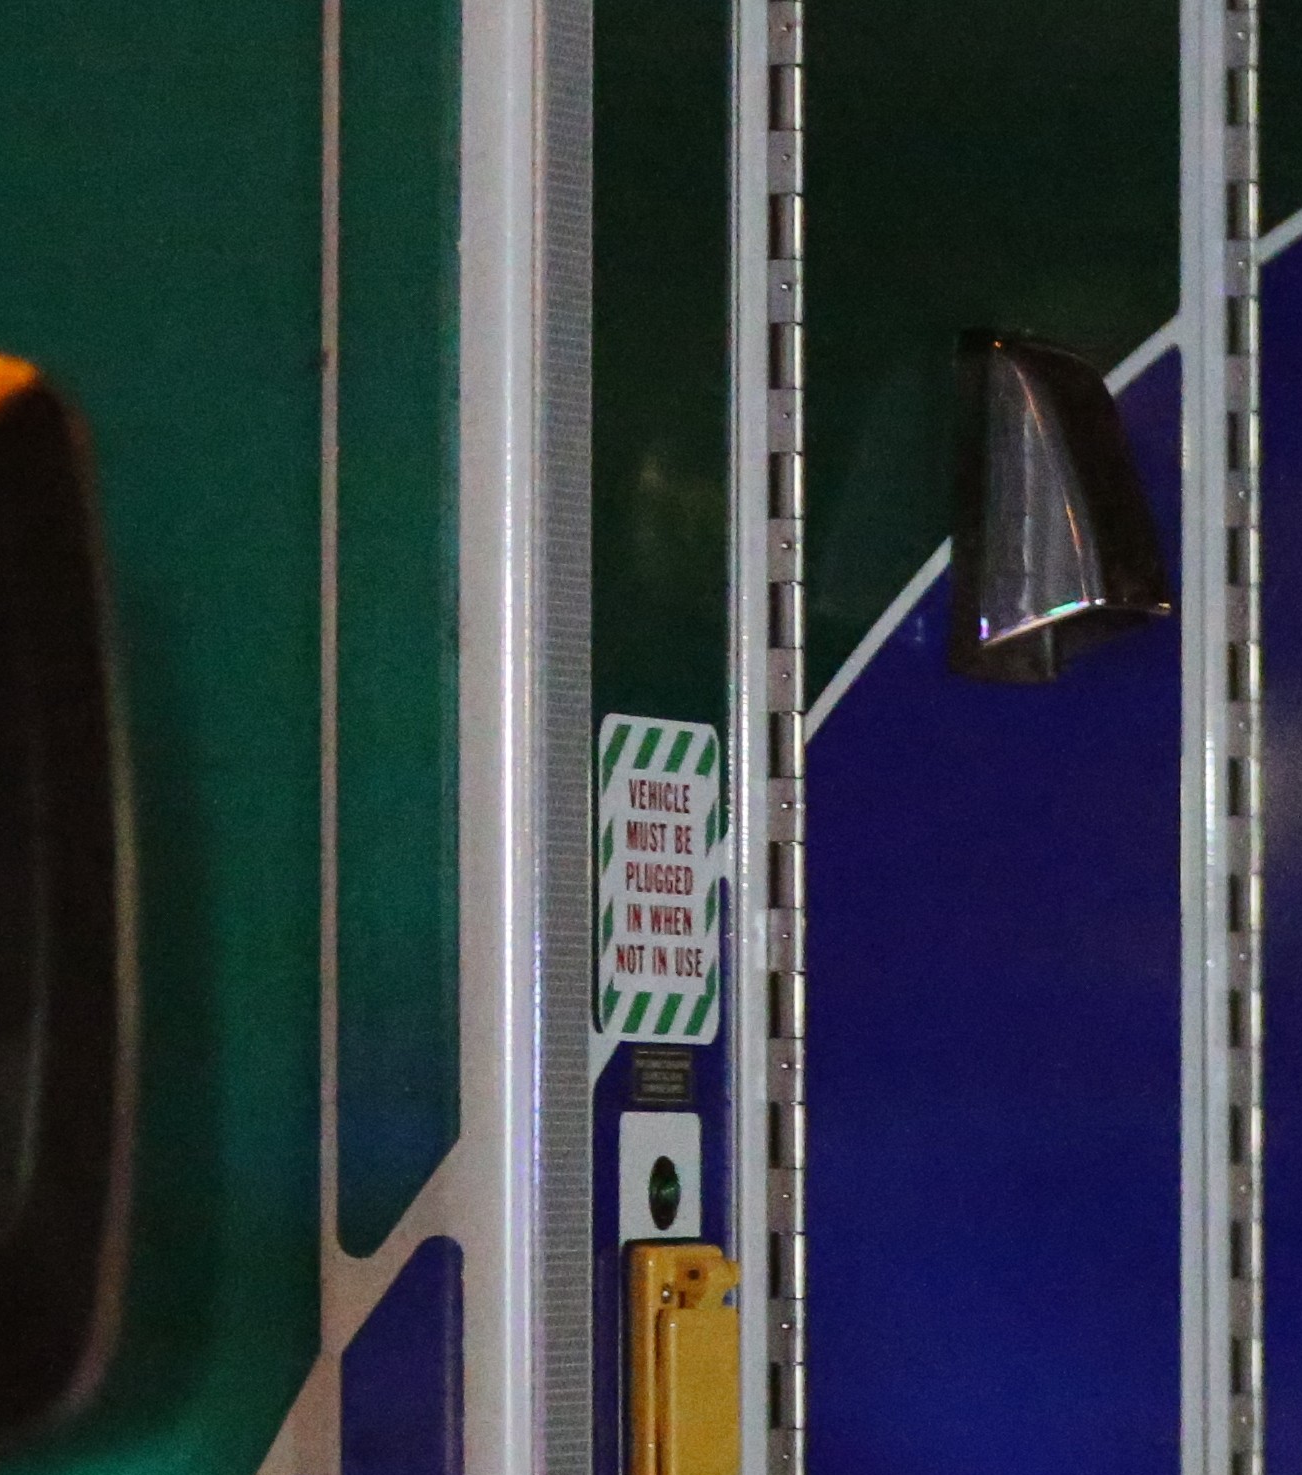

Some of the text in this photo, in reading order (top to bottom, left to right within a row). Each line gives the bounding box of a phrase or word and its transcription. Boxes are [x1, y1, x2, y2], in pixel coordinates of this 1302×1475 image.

[628, 779, 691, 813] VEHICLE
[626, 820, 693, 855] MUST BE
[626, 861, 694, 895] PLUGGED
[627, 903, 693, 936] IN WHEN
[615, 944, 703, 978] NOT IN USE
